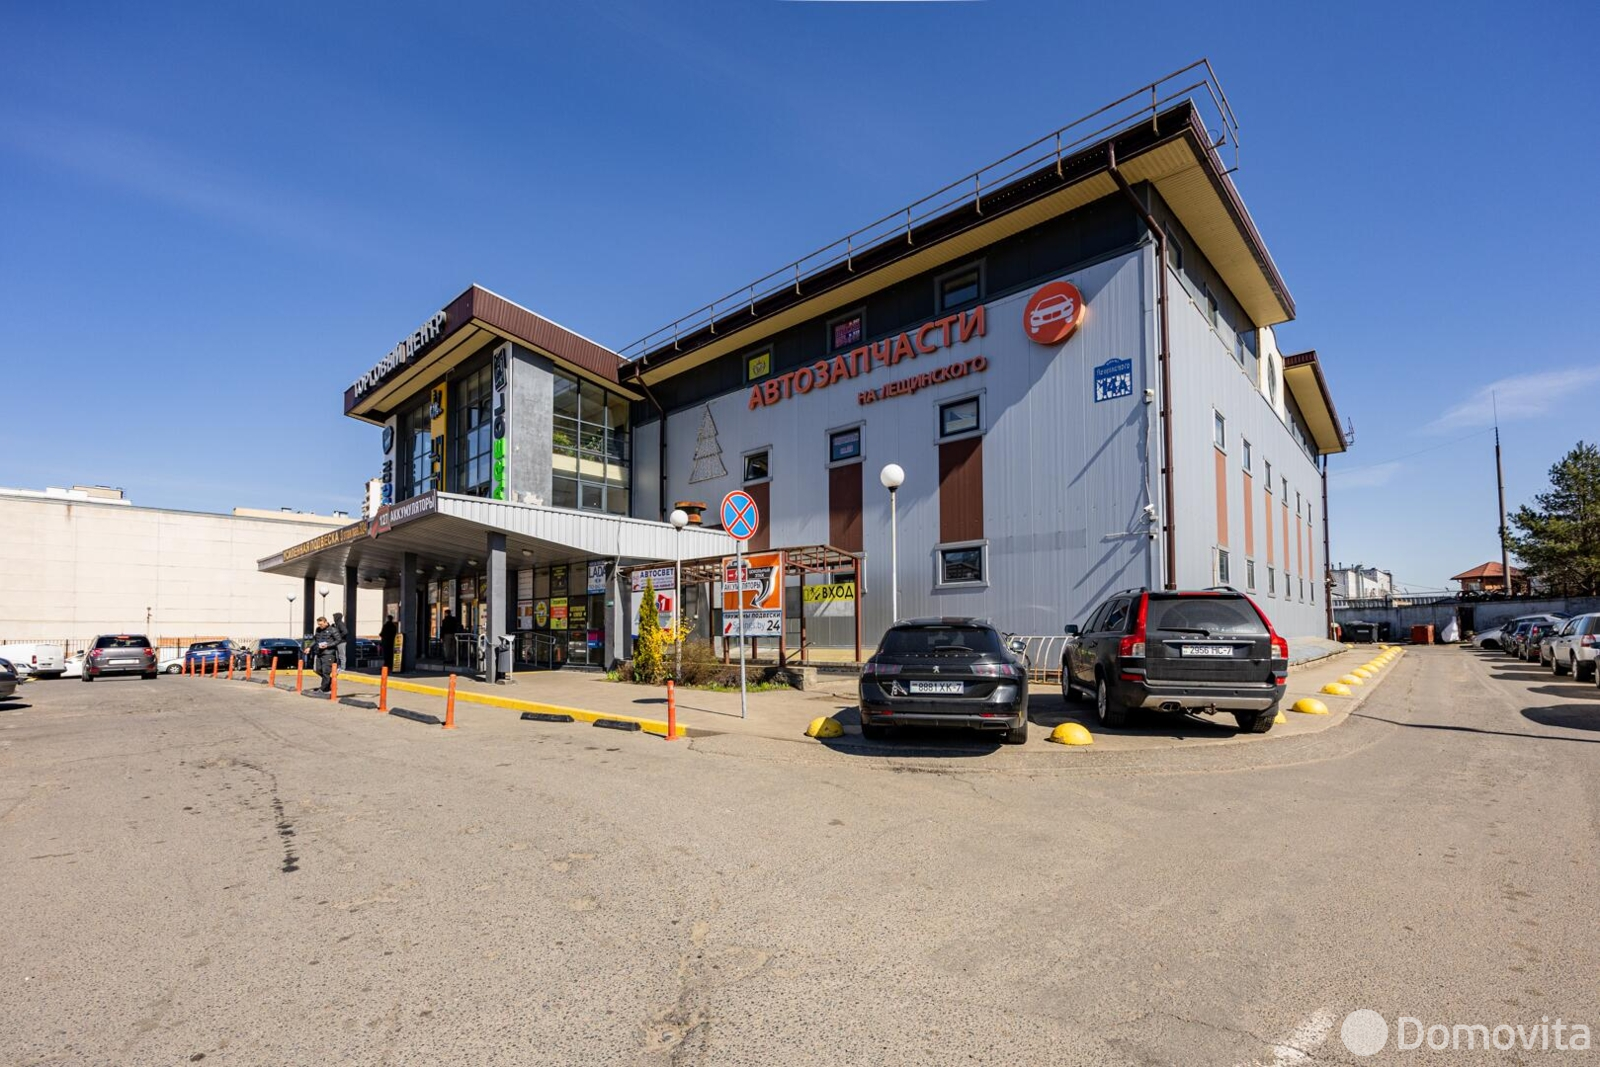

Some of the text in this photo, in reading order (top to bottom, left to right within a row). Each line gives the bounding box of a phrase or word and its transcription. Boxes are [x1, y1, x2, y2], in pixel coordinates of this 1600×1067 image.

[406, 310, 447, 358] ЦЕНТР
[748, 304, 987, 411] АВТОЗАПЧАСТИ
[858, 355, 988, 406] НА ЛЕЩИНСКОГО
[390, 497, 435, 521] АККУМУЛЯТОРЫ
[309, 531, 340, 552] ПОДВЕСКА
[640, 569, 674, 577] АВТОСВЕТ
[822, 585, 854, 599] ВХОД
[751, 610, 780, 619] ПОДВЕСКИ
[766, 620, 780, 631] 24
[1190, 646, 1209, 655] 2956
[940, 683, 962, 692] XK-7
